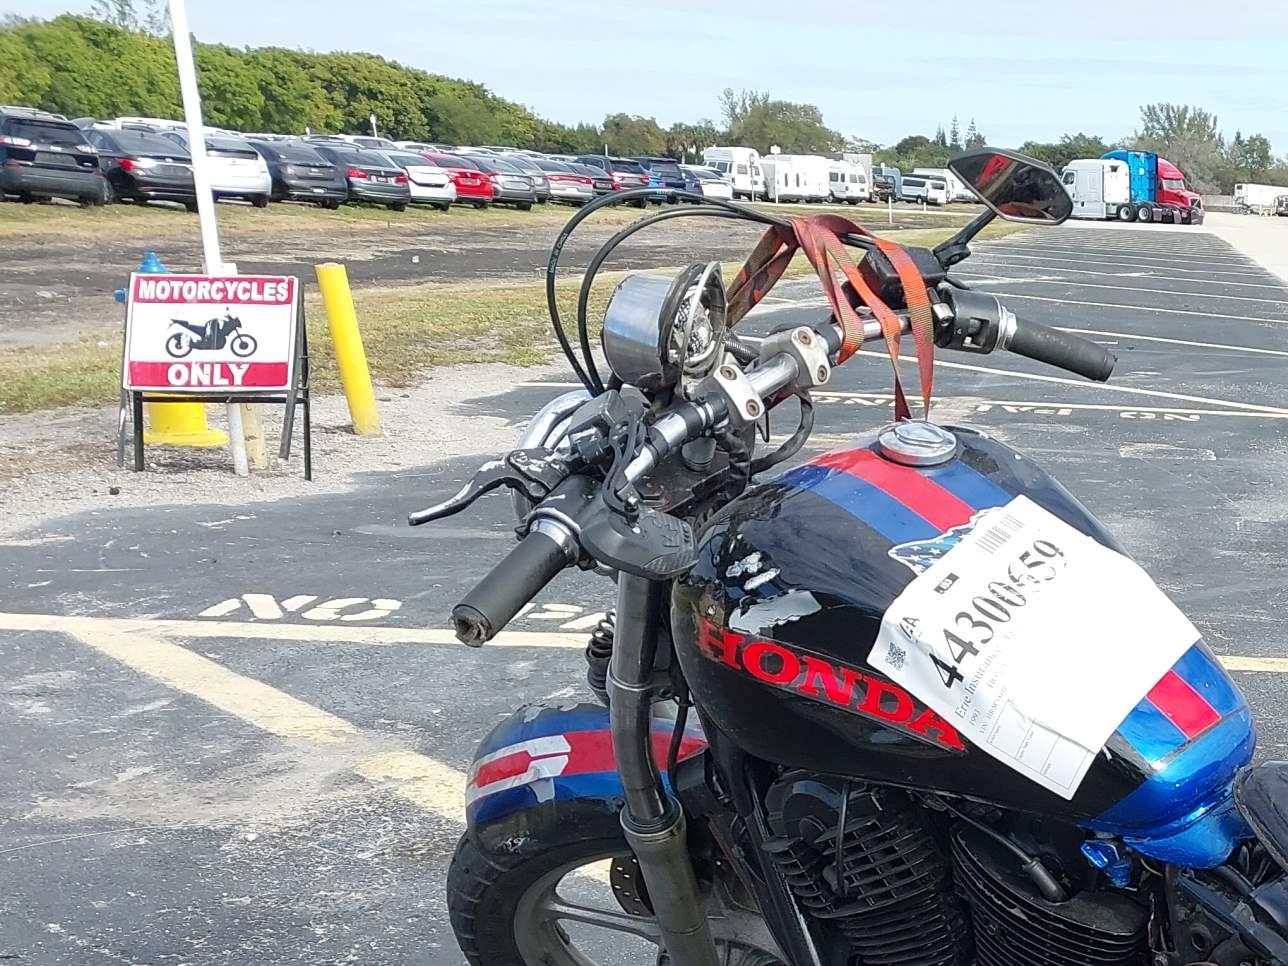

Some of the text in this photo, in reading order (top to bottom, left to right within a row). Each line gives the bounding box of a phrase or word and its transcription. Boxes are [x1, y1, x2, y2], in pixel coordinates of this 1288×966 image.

[138, 278, 289, 301] MOTORCYCLES
[167, 362, 251, 386] ONLY
[197, 593, 403, 620] NO
[695, 614, 968, 752] HONDA
